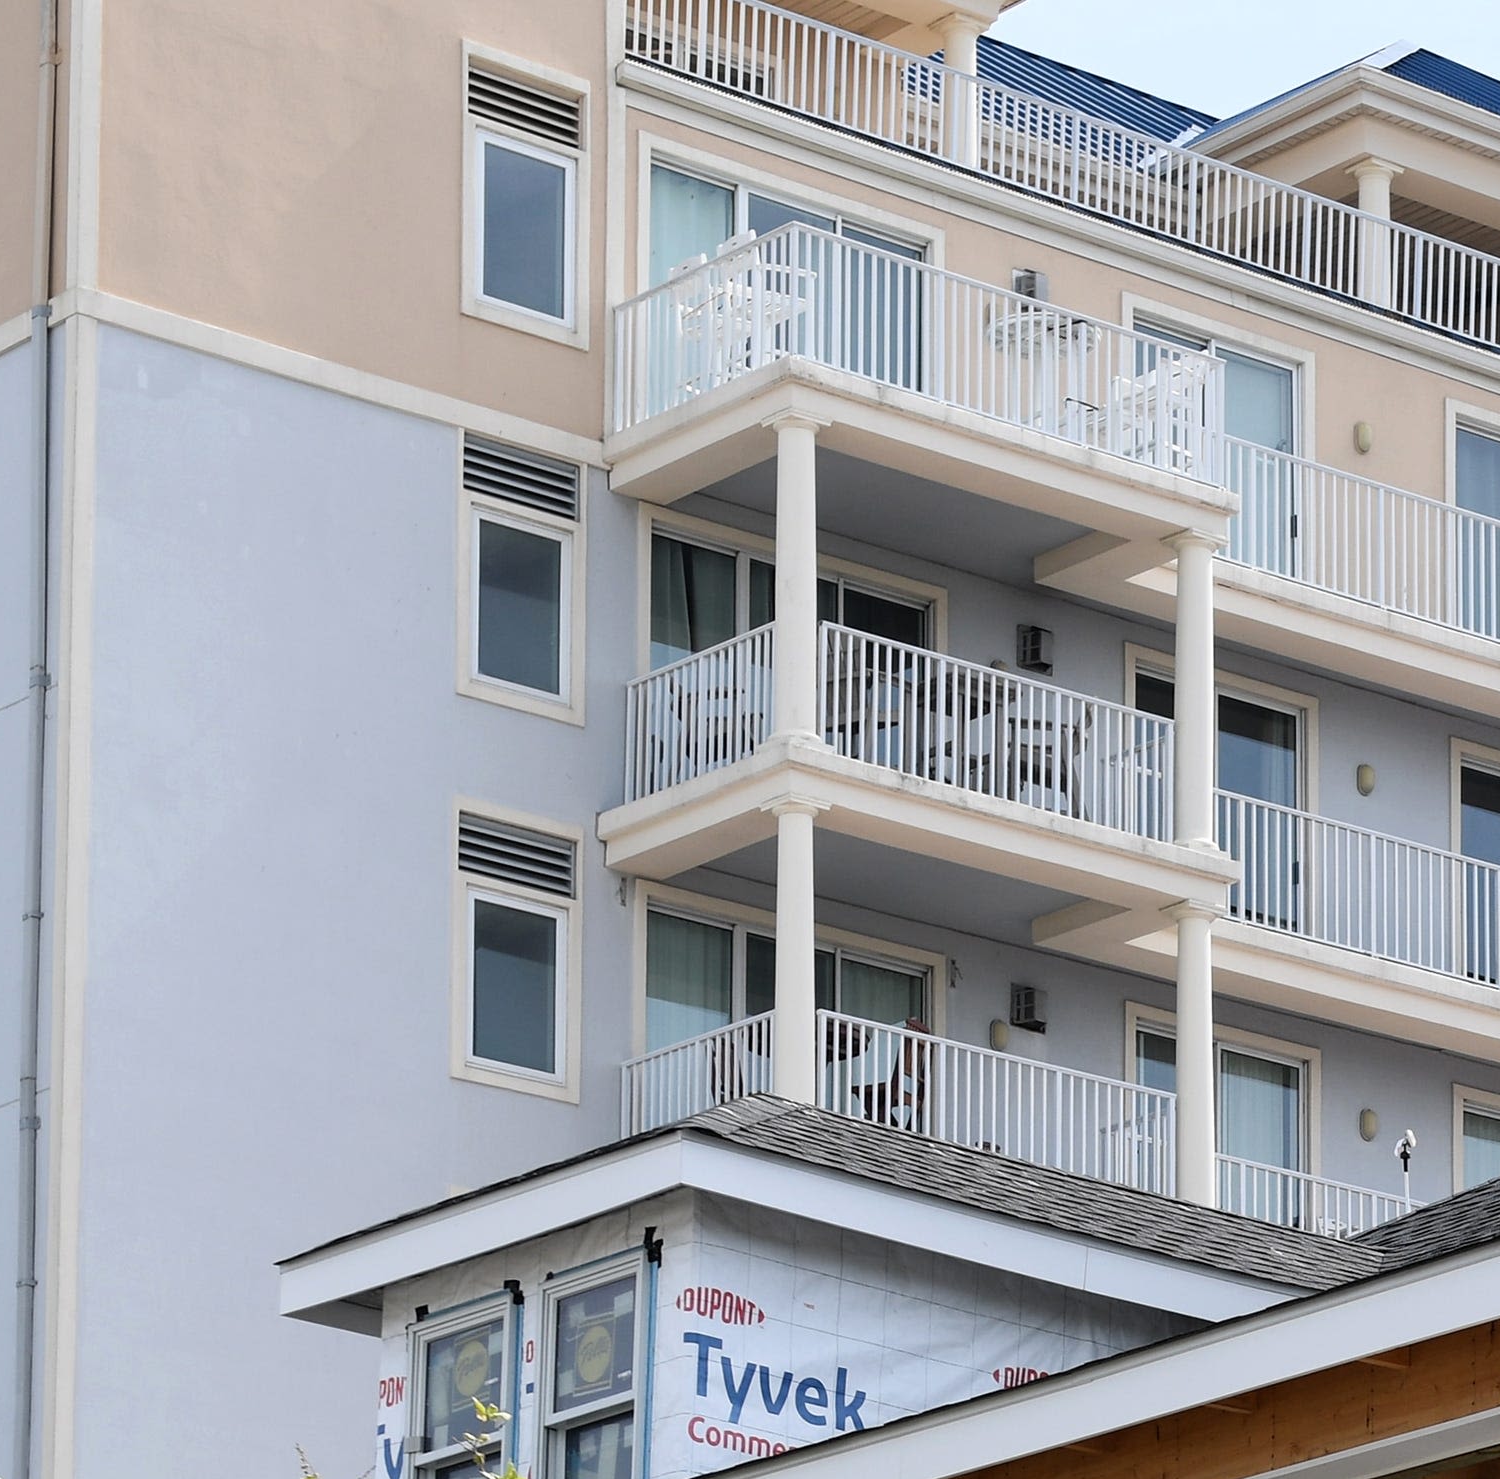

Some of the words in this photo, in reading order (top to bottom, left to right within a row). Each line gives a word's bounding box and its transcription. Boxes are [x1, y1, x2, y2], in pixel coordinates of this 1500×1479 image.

[684, 1287, 756, 1326] DUPONT
[683, 1331, 867, 1432] Tyvek
[688, 1416, 801, 1457] Comme
